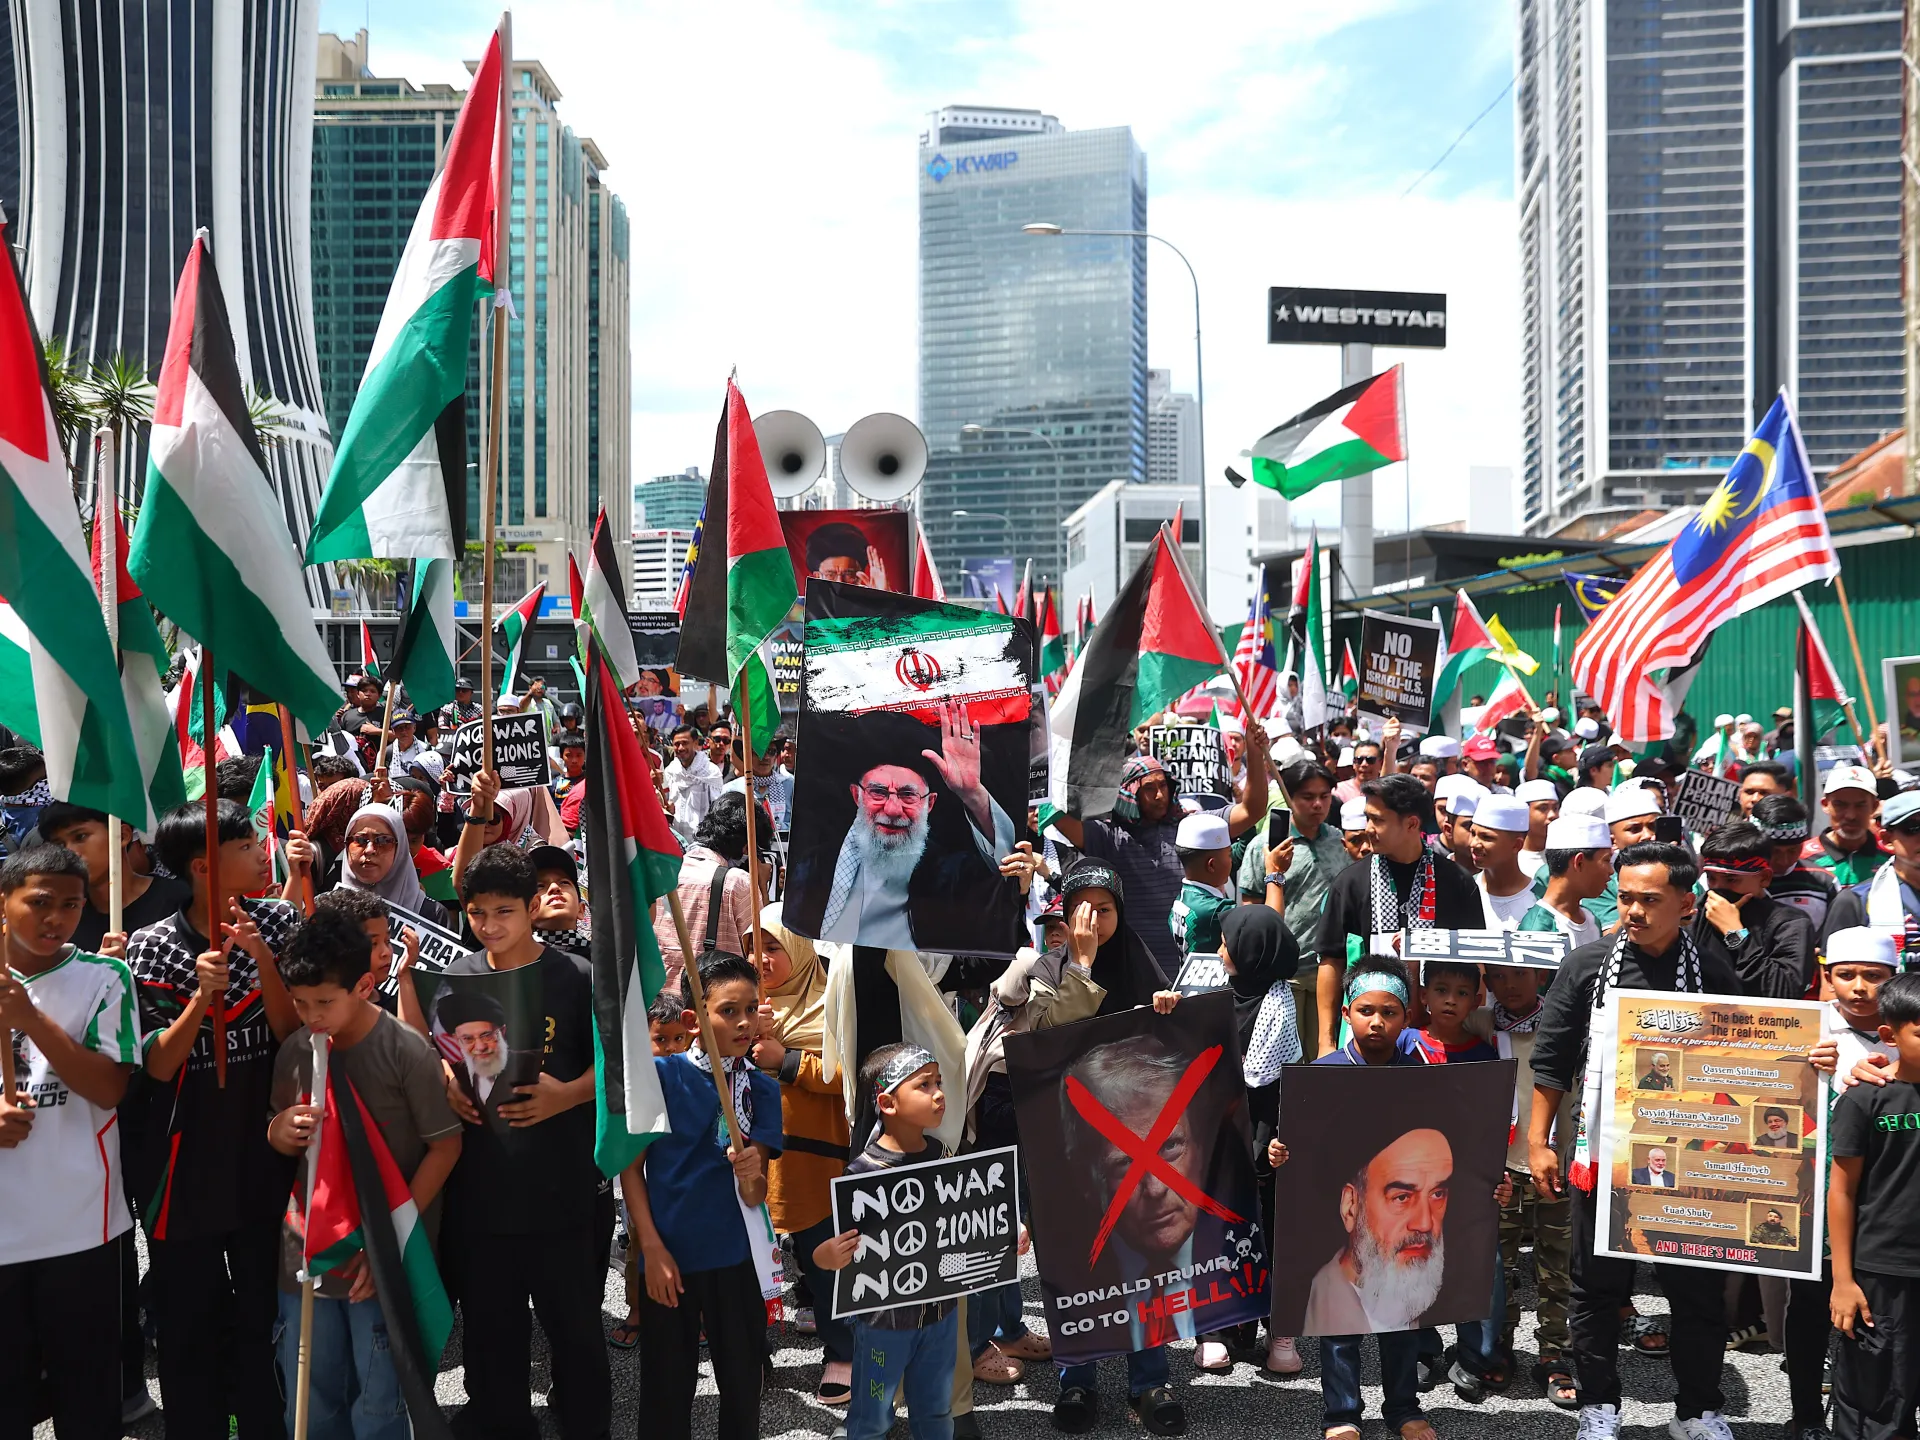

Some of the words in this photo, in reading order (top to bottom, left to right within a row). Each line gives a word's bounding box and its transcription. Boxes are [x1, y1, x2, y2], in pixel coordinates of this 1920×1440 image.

[1294, 305, 1446, 329] WESTSTAR
[1383, 631, 1413, 658] NO
[1371, 652, 1390, 673] TO
[1394, 658, 1422, 680] THE
[1366, 669, 1424, 695] ISRAELI-U.S.
[1364, 682, 1384, 698] WAR
[1385, 688, 1398, 702] ON
[1399, 693, 1425, 708] IRAN!
[393, 712, 408, 720] NAVY
[493, 719, 537, 740] WAR
[495, 741, 541, 763] ZIONIS
[1029, 769, 1047, 779] EAM
[1168, 762, 1219, 780] OLAK
[1688, 773, 1737, 801] TOLAK
[1679, 800, 1729, 826] TOLAK
[1180, 959, 1230, 987] BERSA
[1711, 1011, 1729, 1023] The
[1732, 1013, 1754, 1025] best
[1758, 1016, 1803, 1029] example.
[1648, 1035, 1670, 1043] value
[1729, 1040, 1751, 1048] what
[1762, 1043, 1784, 1051] does
[1710, 1025, 1728, 1036] The
[1731, 1027, 1751, 1038] real
[1754, 1028, 1778, 1040] icon.
[227, 1054, 253, 1064] ACRED
[1703, 1064, 1734, 1075] Qassem
[1735, 1067, 1778, 1078] Sulaimani
[31, 1082, 59, 1093] FOR
[1639, 1108, 1666, 1118] Sayyid
[1667, 1109, 1698, 1120] Hassan
[1698, 1113, 1740, 1123] Nasrallah
[1704, 1161, 1731, 1170] Ismail
[934, 1162, 1006, 1204] WAR
[1664, 1205, 1685, 1214] Fuad
[1687, 1208, 1711, 1219] Shukr
[935, 1203, 1009, 1249] ZIONIS
[1656, 1240, 1678, 1253] AND
[1681, 1243, 1723, 1258] THERE'S
[1726, 1247, 1759, 1262] MORE.
[1056, 1278, 1151, 1310] DONALD
[1060, 1318, 1095, 1336] GO
[1098, 1309, 1130, 1328] TO
